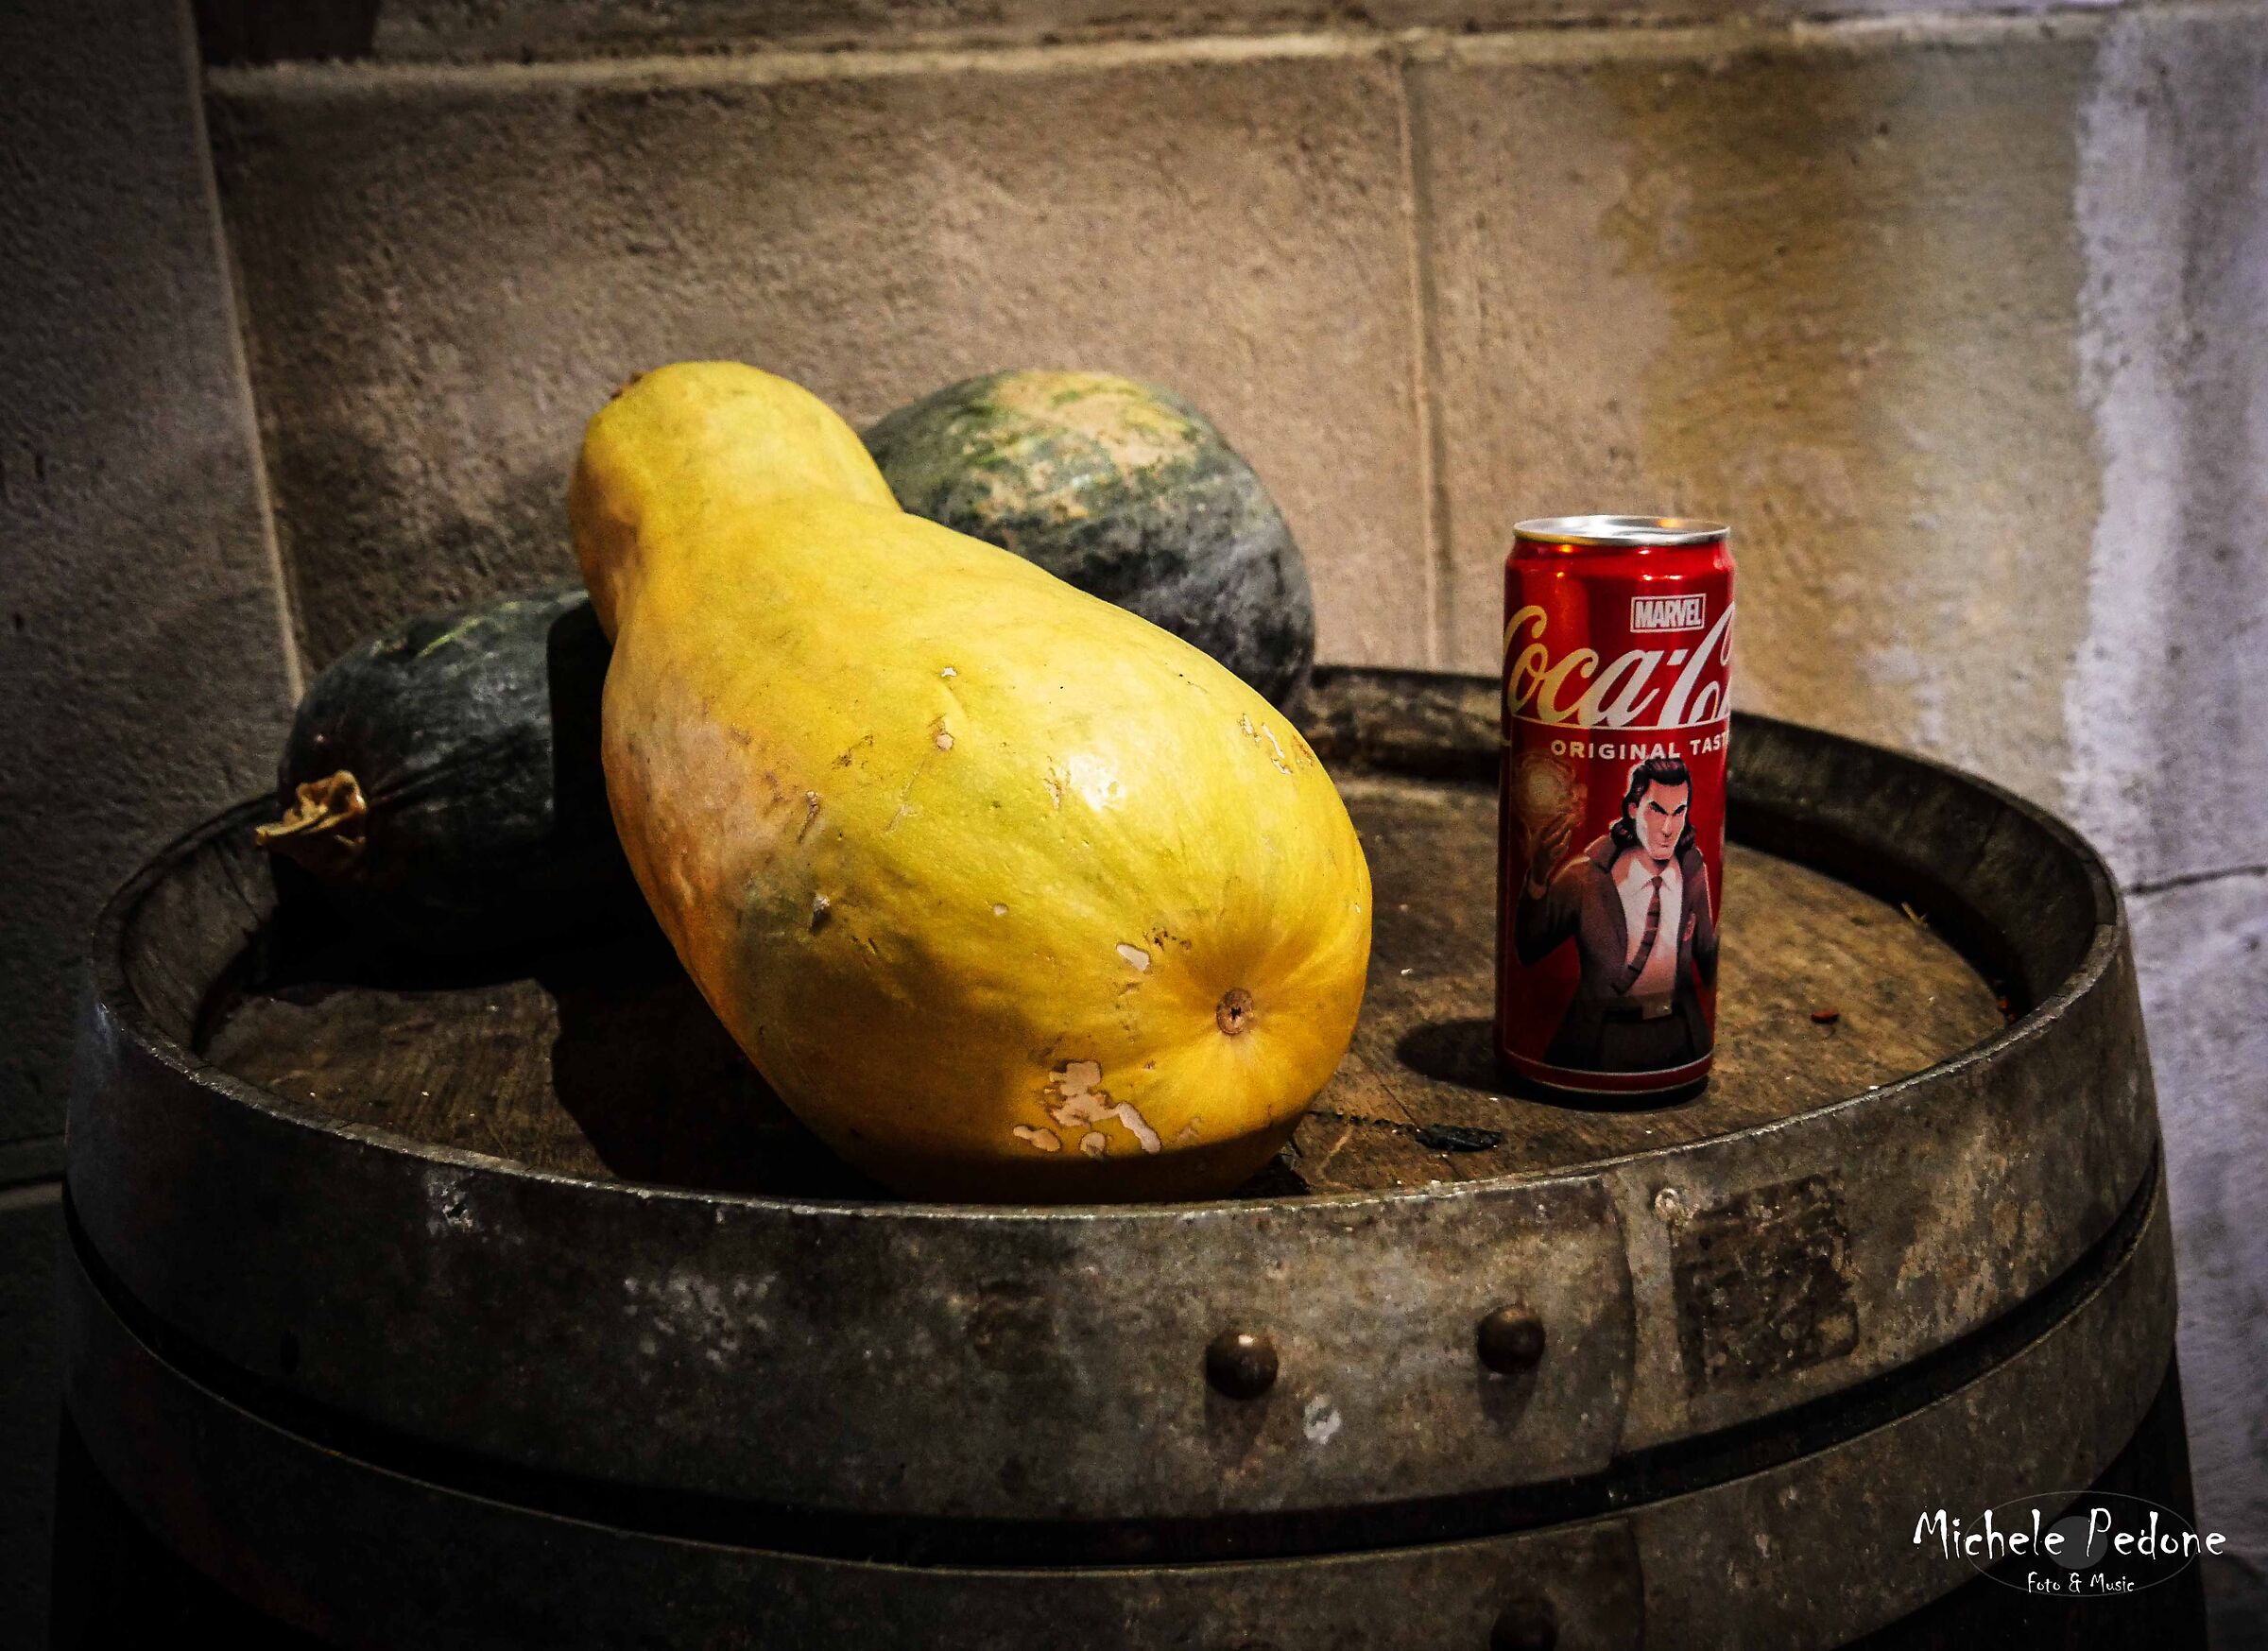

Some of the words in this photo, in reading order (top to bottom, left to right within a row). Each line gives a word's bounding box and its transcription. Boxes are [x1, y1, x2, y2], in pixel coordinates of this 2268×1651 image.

[1635, 598, 1701, 628] MARVEL
[1551, 739, 1680, 760] ORIGINAL
[1690, 731, 1729, 755] TAST
